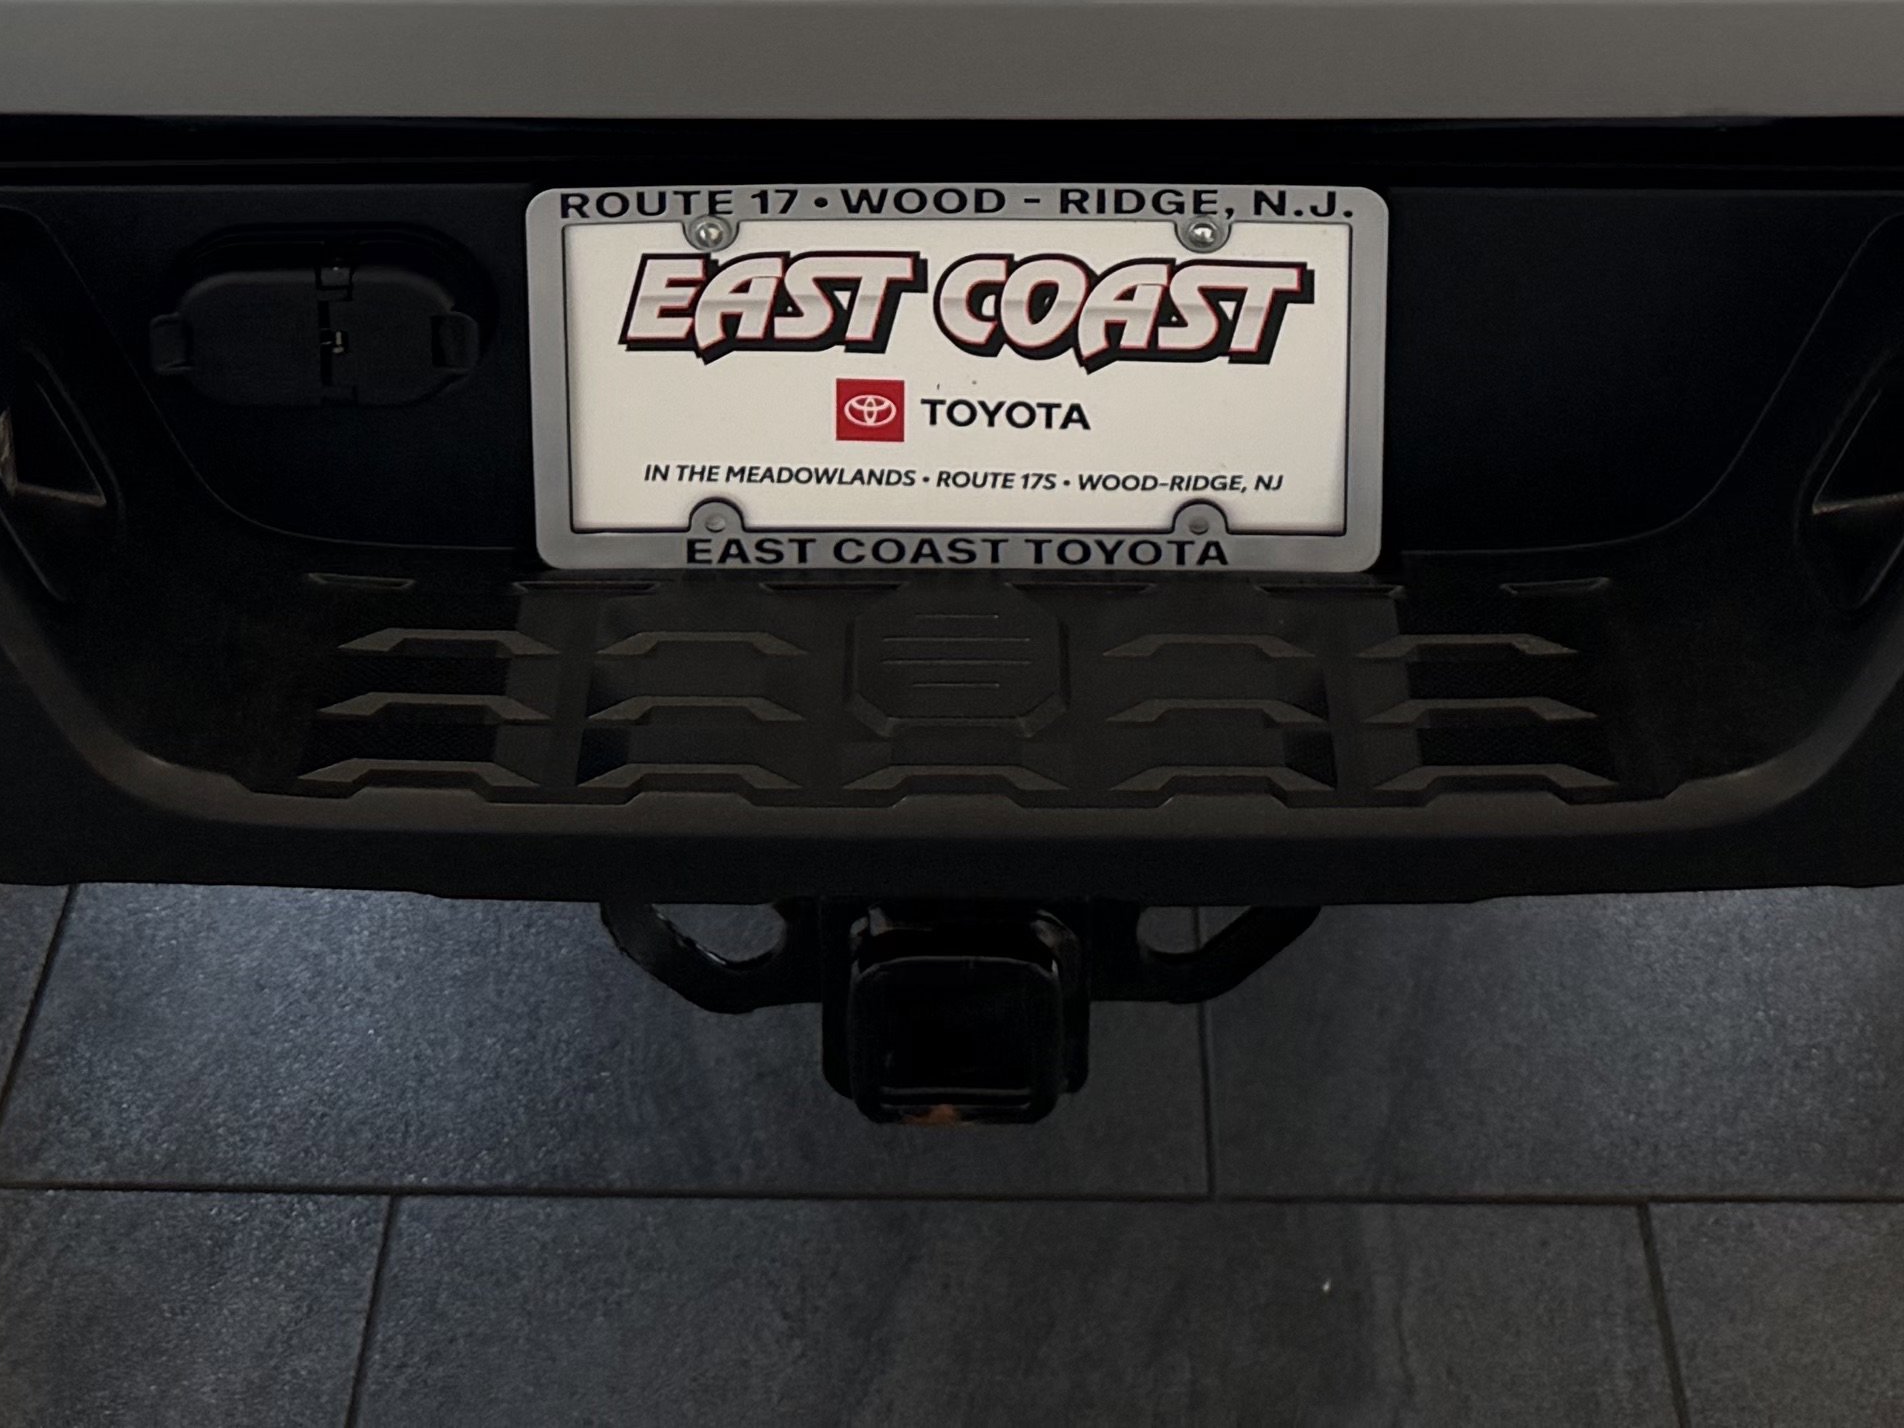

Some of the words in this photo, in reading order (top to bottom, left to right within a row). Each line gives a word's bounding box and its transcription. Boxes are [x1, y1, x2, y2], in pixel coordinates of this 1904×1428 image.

[560, 189, 733, 219] ROUTE
[751, 189, 798, 215] 17
[840, 187, 1006, 215] WOOD
[1059, 188, 1234, 220] RIDGE,
[1253, 189, 1354, 218] N.J.
[618, 251, 928, 365] EAST
[933, 252, 1315, 375] COAST
[921, 398, 1091, 431] TOYOTA
[644, 464, 670, 482] IN
[676, 465, 720, 482] THE
[725, 465, 916, 487] MEADOWLANDS
[936, 470, 1015, 490] ROUTE
[1021, 472, 1057, 491] 17S
[1078, 474, 1248, 494] WOOD-RIDGE,
[1254, 475, 1284, 491] NJ
[686, 537, 816, 565] EAST
[833, 537, 1009, 565] COAST
[1023, 537, 1229, 566] TOYOTA
